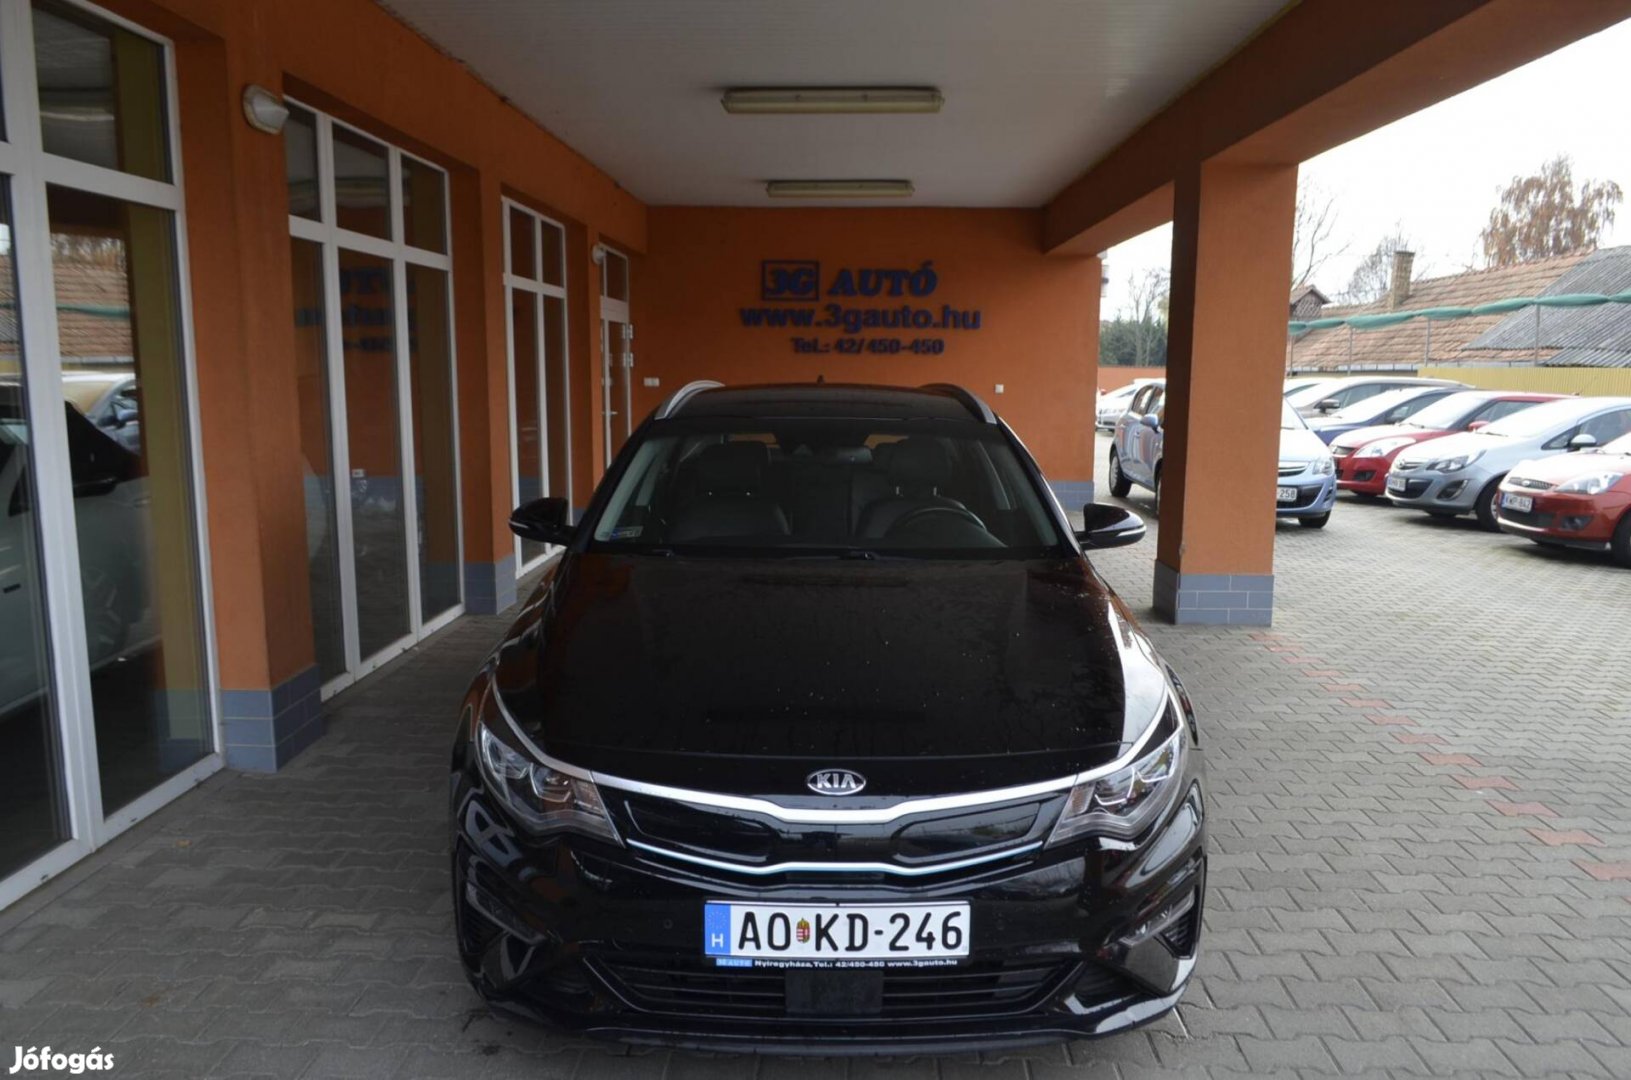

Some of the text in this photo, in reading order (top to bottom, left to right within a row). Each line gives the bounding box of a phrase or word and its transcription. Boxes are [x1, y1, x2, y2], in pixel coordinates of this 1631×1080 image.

[827, 259, 938, 297] AUTÓ
[740, 303, 981, 333] www.3gauto.hu
[816, 772, 857, 789] KIA
[711, 933, 724, 948] H
[887, 959, 958, 968] www.3gauto.hu
